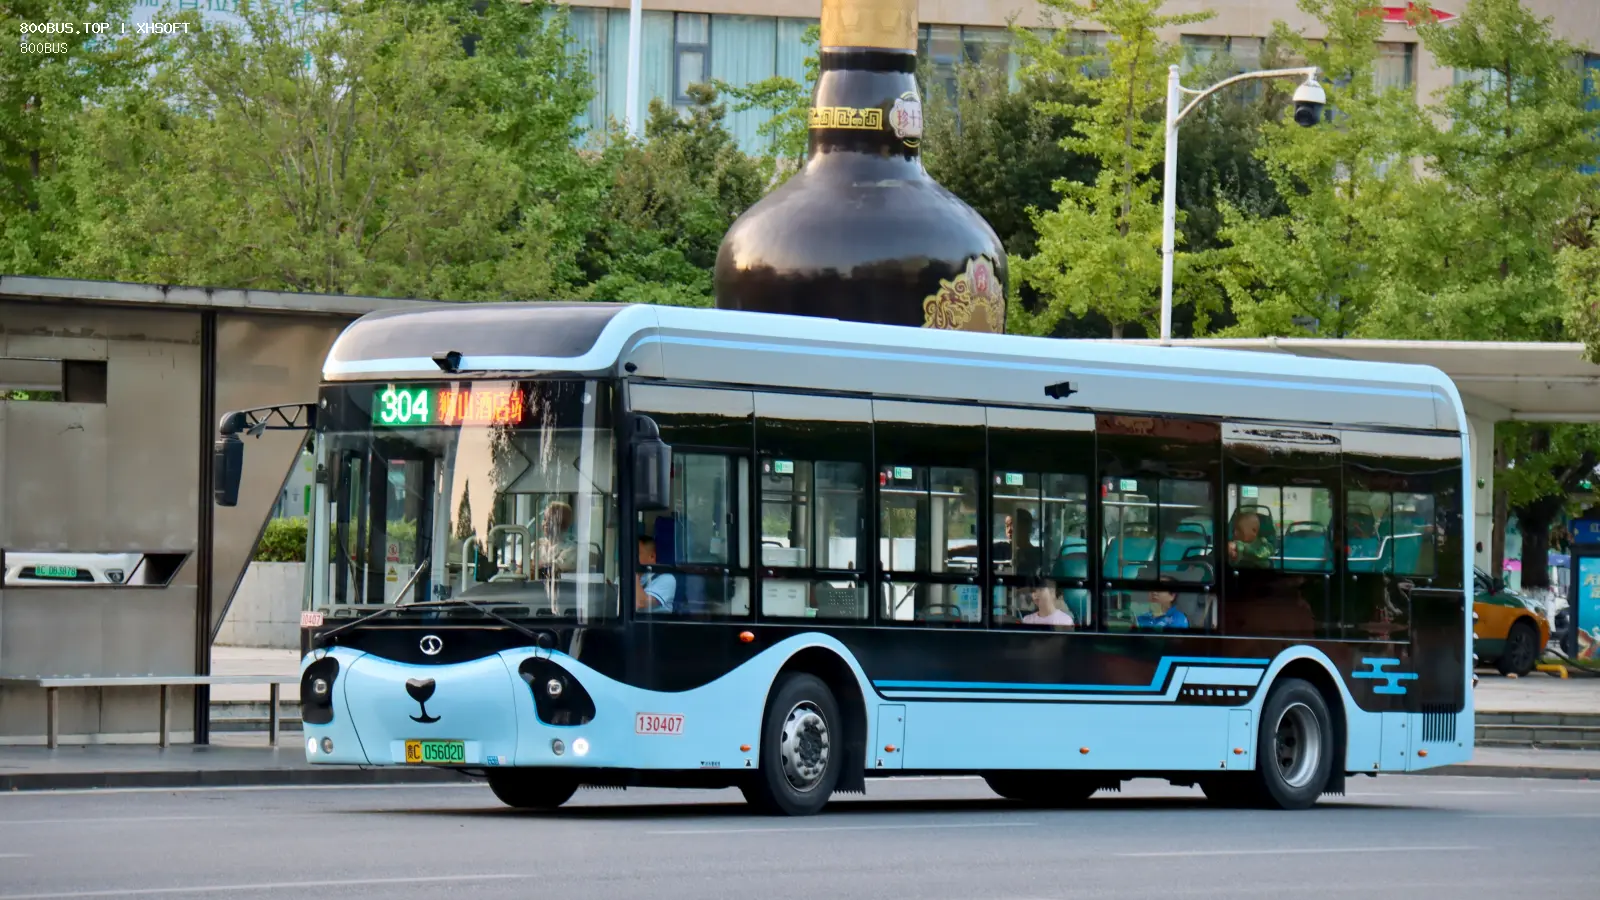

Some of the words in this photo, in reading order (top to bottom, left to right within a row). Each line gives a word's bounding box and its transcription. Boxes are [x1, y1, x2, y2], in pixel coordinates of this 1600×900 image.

[381, 390, 429, 422] 304
[639, 716, 683, 732] 130407
[424, 744, 464, 760] 05602D
